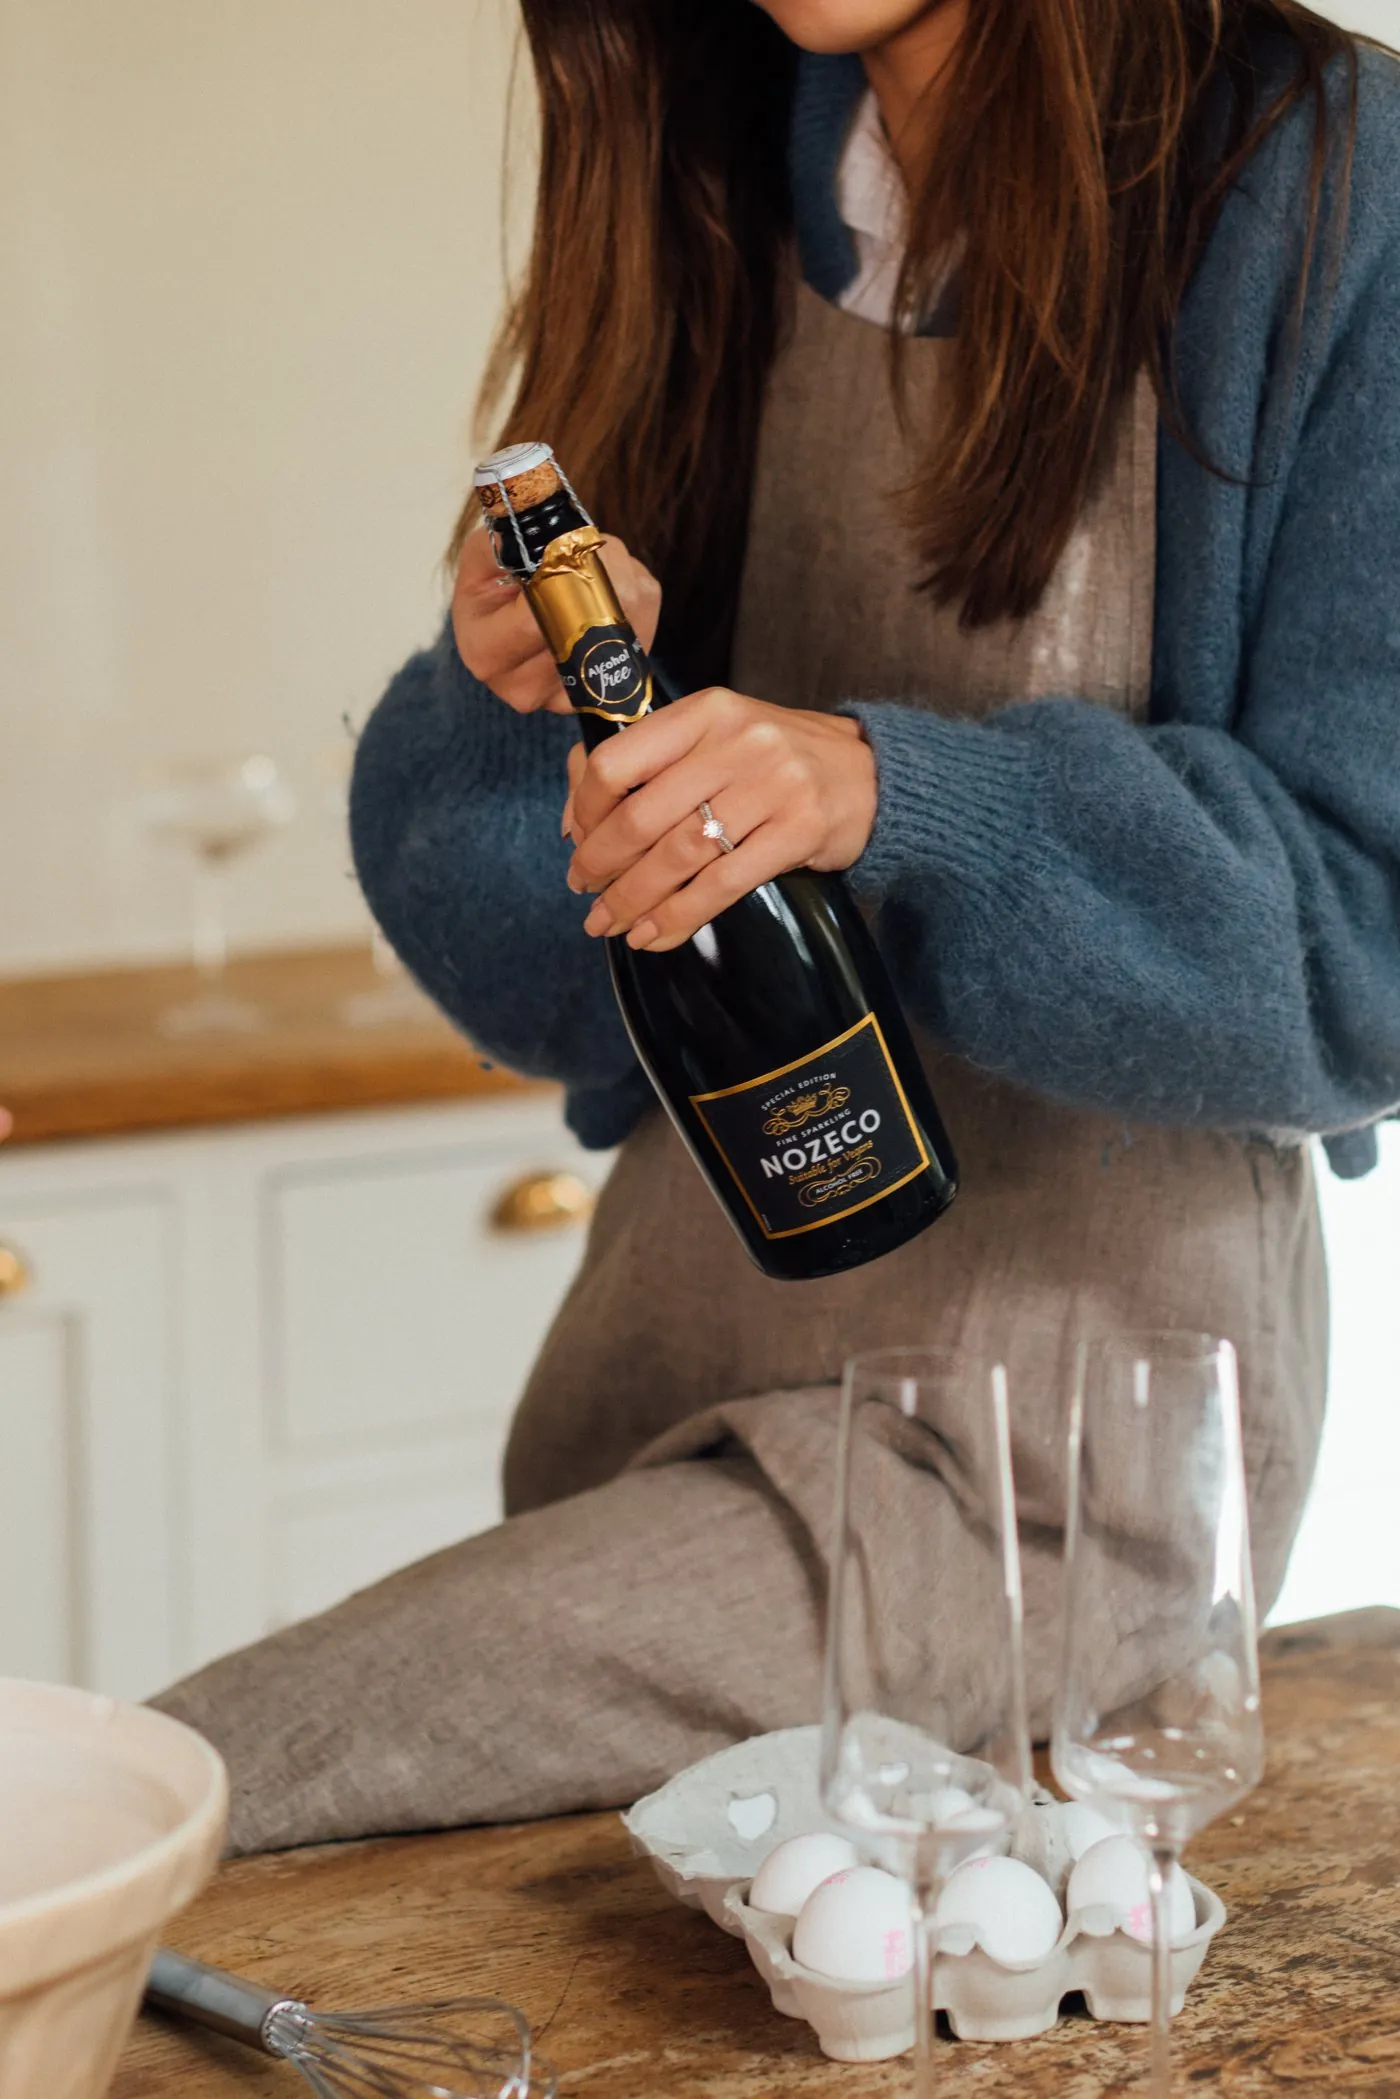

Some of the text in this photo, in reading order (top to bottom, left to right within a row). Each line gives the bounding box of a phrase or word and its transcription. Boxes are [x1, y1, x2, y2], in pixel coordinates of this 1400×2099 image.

[588, 649, 630, 678] Alcohol
[597, 666, 632, 706] free
[761, 1072, 836, 1111] SPECIAL EDITION
[760, 1109, 880, 1178] NOZECO
[776, 1108, 851, 1147] FINE SPARKLING
[788, 1140, 873, 1185] Suitable for Vegans
[815, 1168, 863, 1194] ALCOHOL FREE
